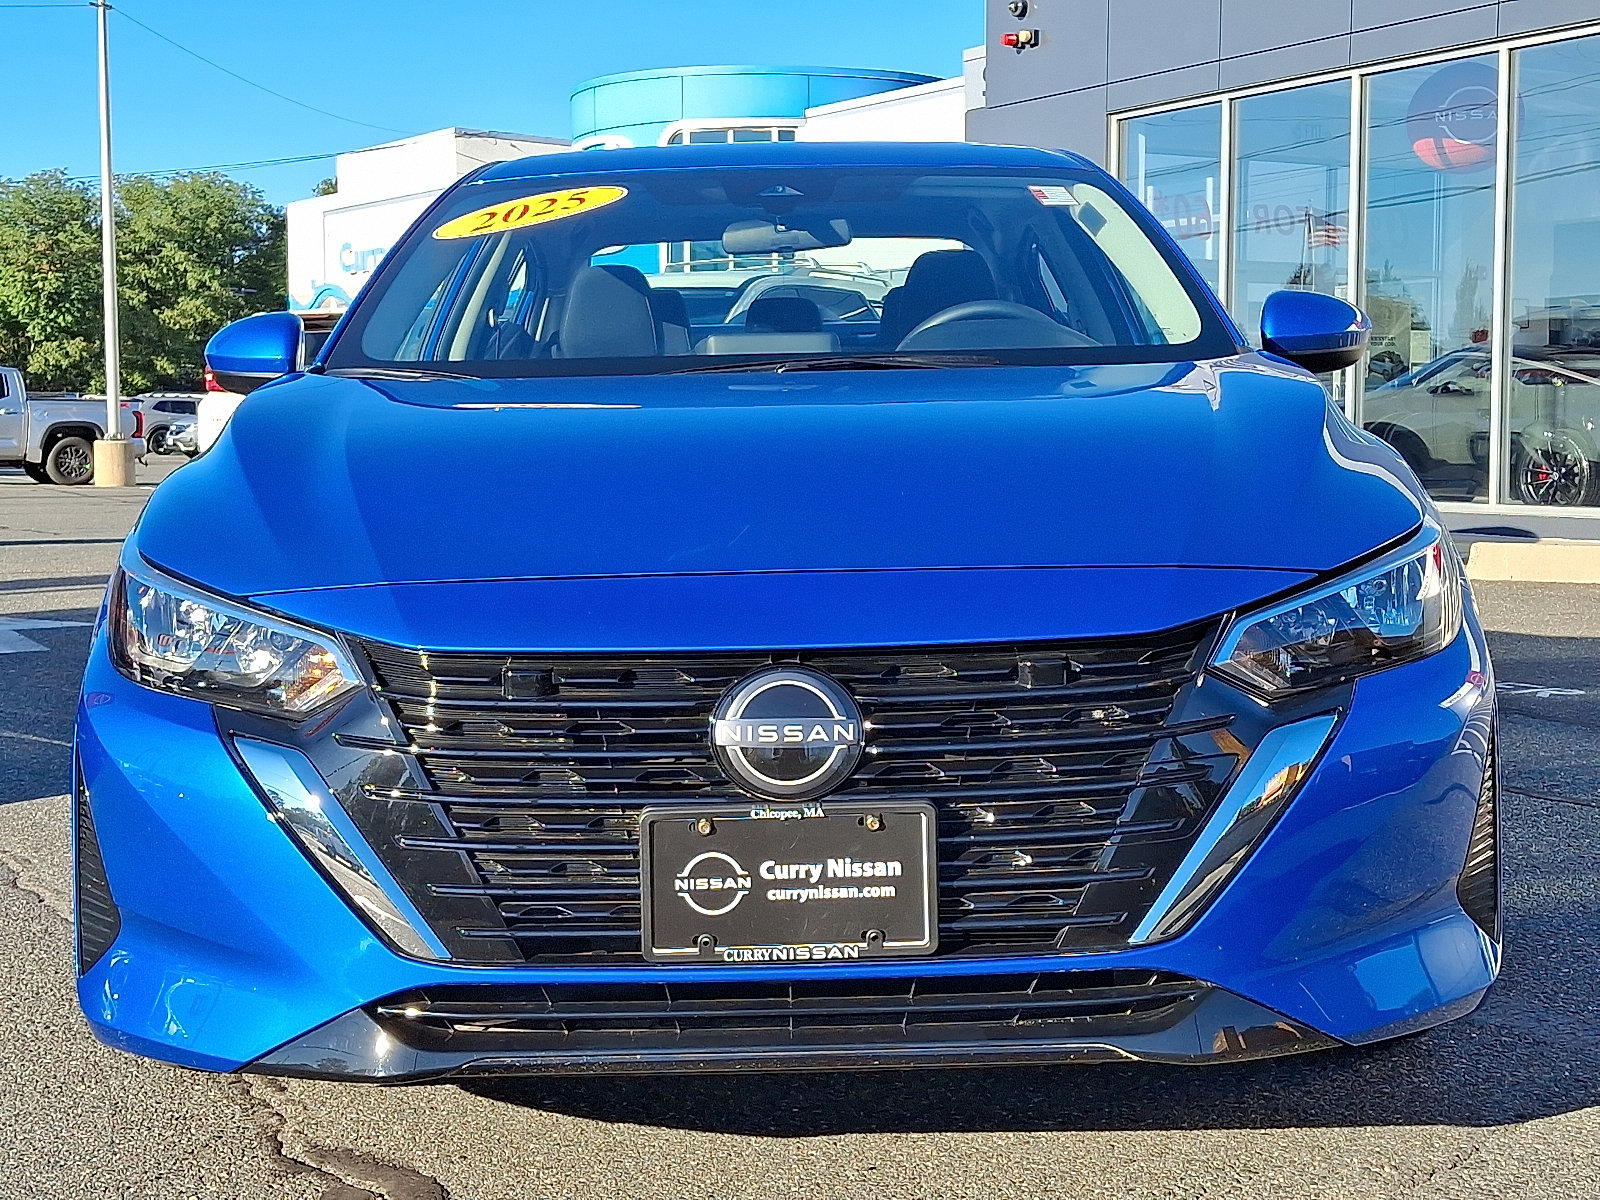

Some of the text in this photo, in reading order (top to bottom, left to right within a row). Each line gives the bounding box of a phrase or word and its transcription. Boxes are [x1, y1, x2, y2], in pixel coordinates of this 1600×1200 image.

[1435, 110, 1497, 122] NISSA
[471, 190, 590, 232] 2025
[340, 242, 385, 272] Curr
[722, 723, 856, 743] NISSAN
[750, 807, 826, 821] Chicopee, MA
[759, 857, 902, 883] Curry Nissan
[674, 877, 752, 890] NISSAN
[767, 885, 896, 903] currynissan.com
